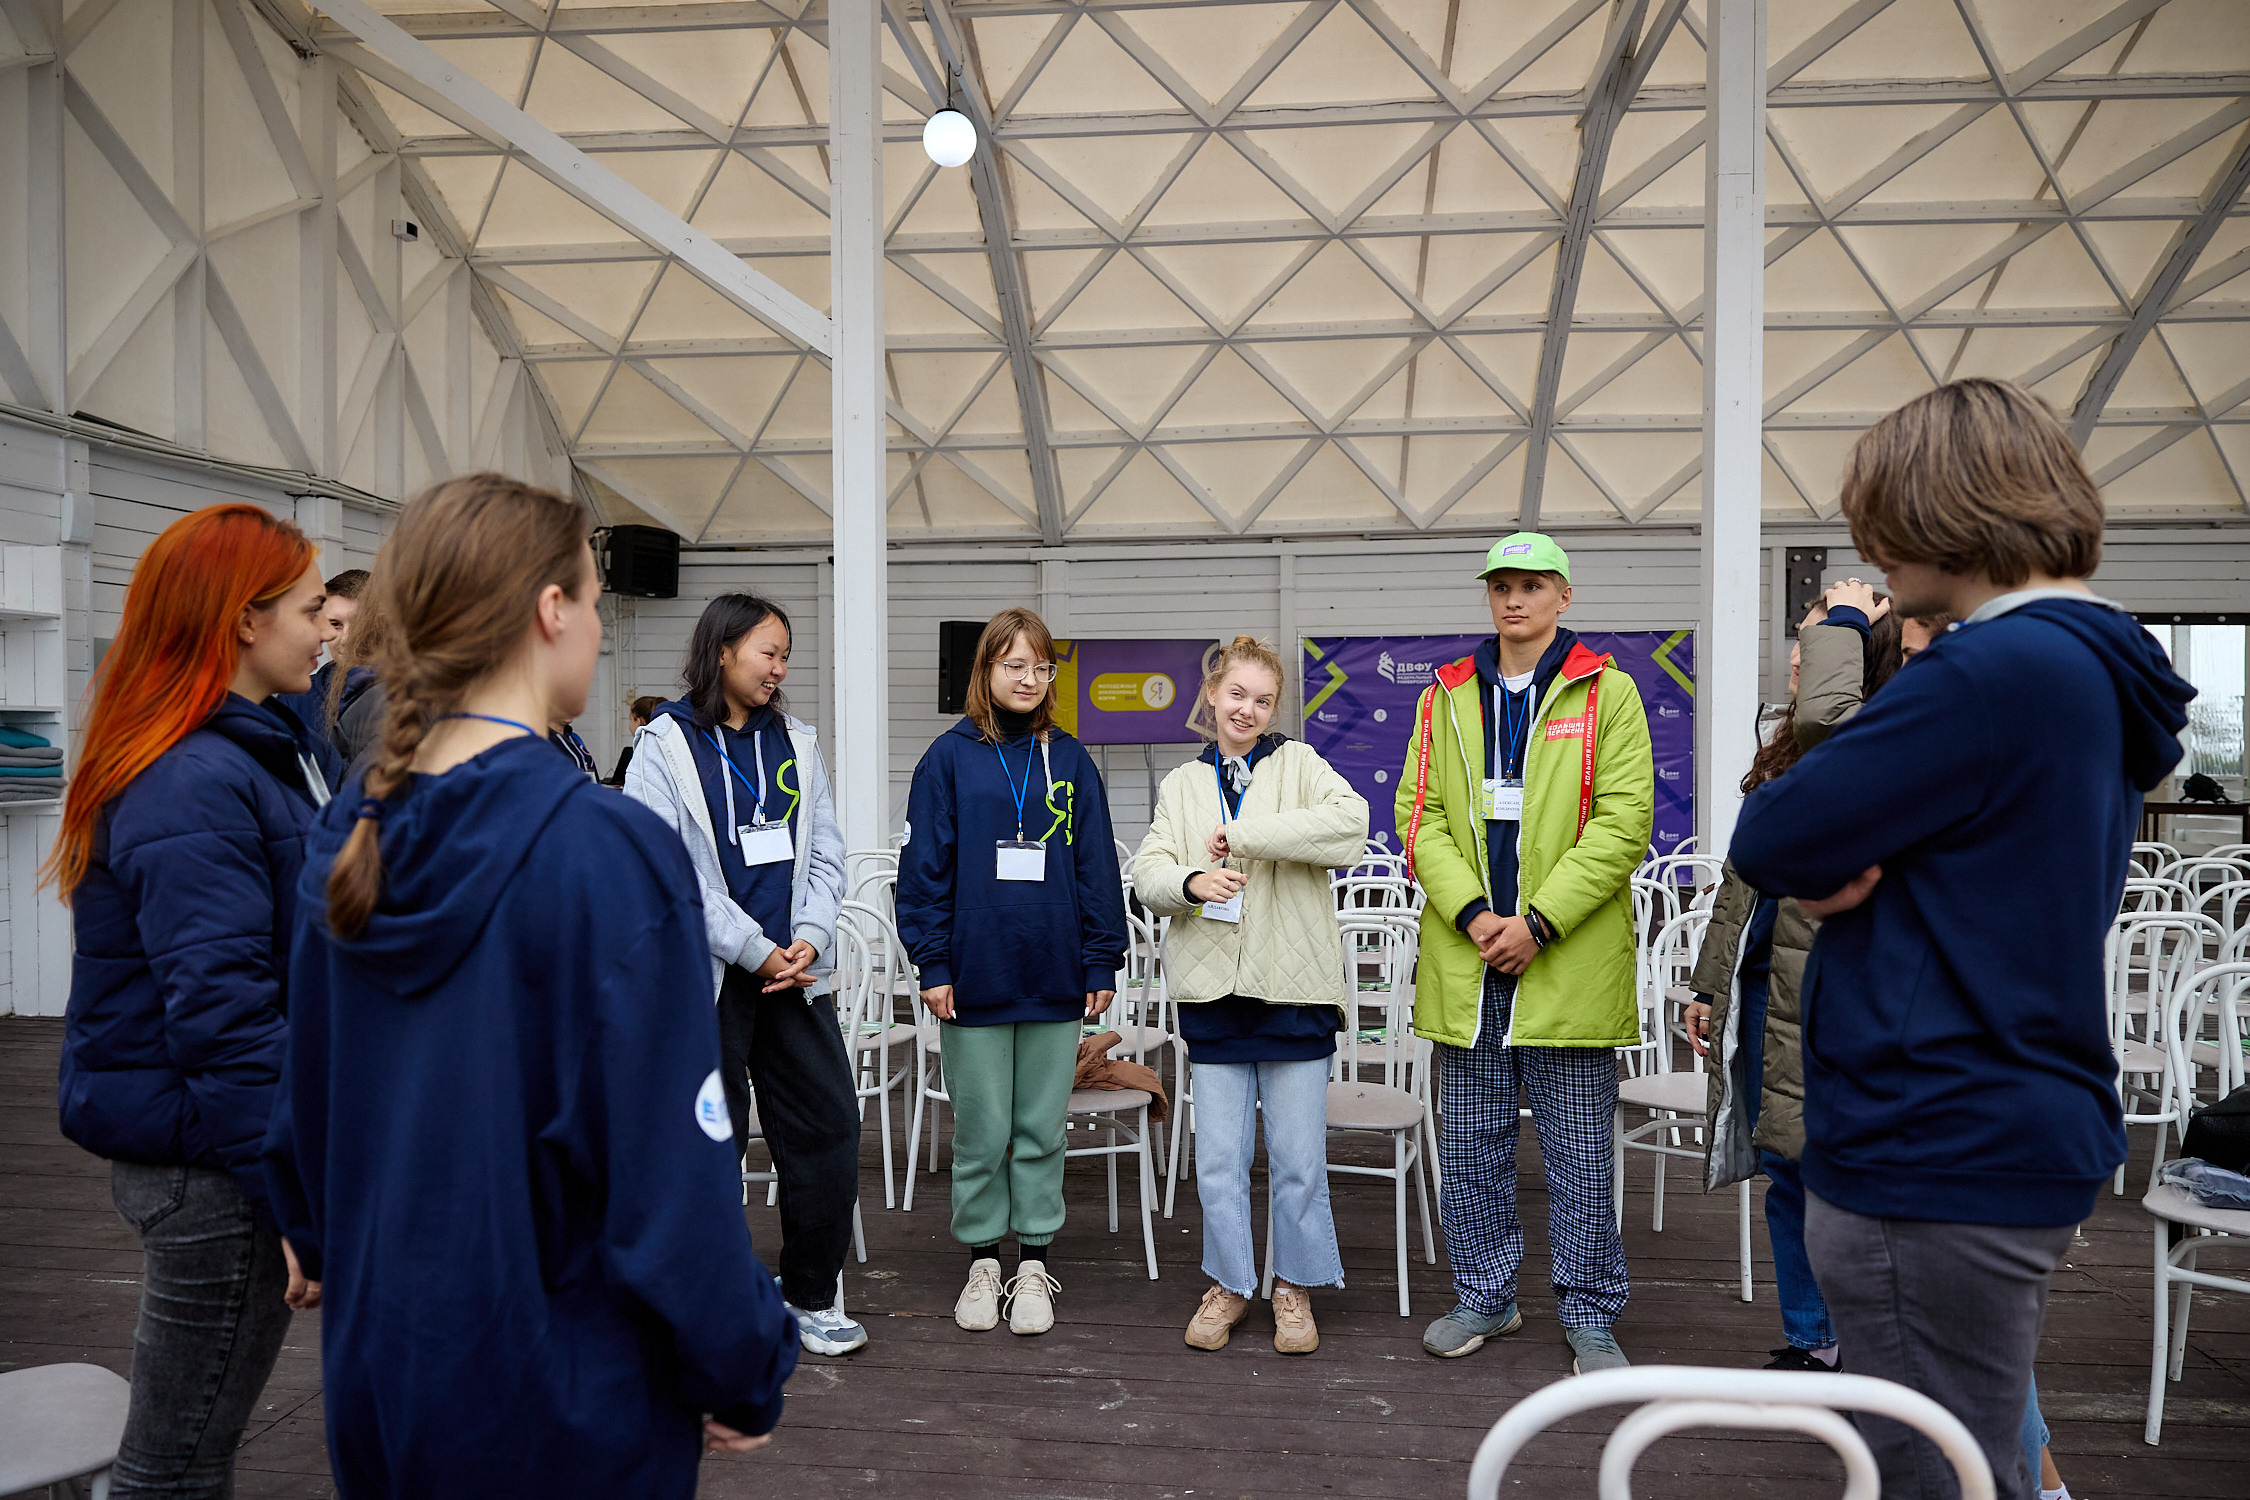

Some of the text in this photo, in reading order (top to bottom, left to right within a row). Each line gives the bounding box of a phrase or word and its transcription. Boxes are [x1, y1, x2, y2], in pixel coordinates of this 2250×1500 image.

[1396, 662, 1432, 673] ДВФУ
[1584, 713, 1594, 786] БОЛЬШАЯ ПЕРЕМЕНА
[1419, 753, 1427, 787] ПЕРЕМЕНА
[1410, 804, 1421, 838] БОЛЬШАЯ
